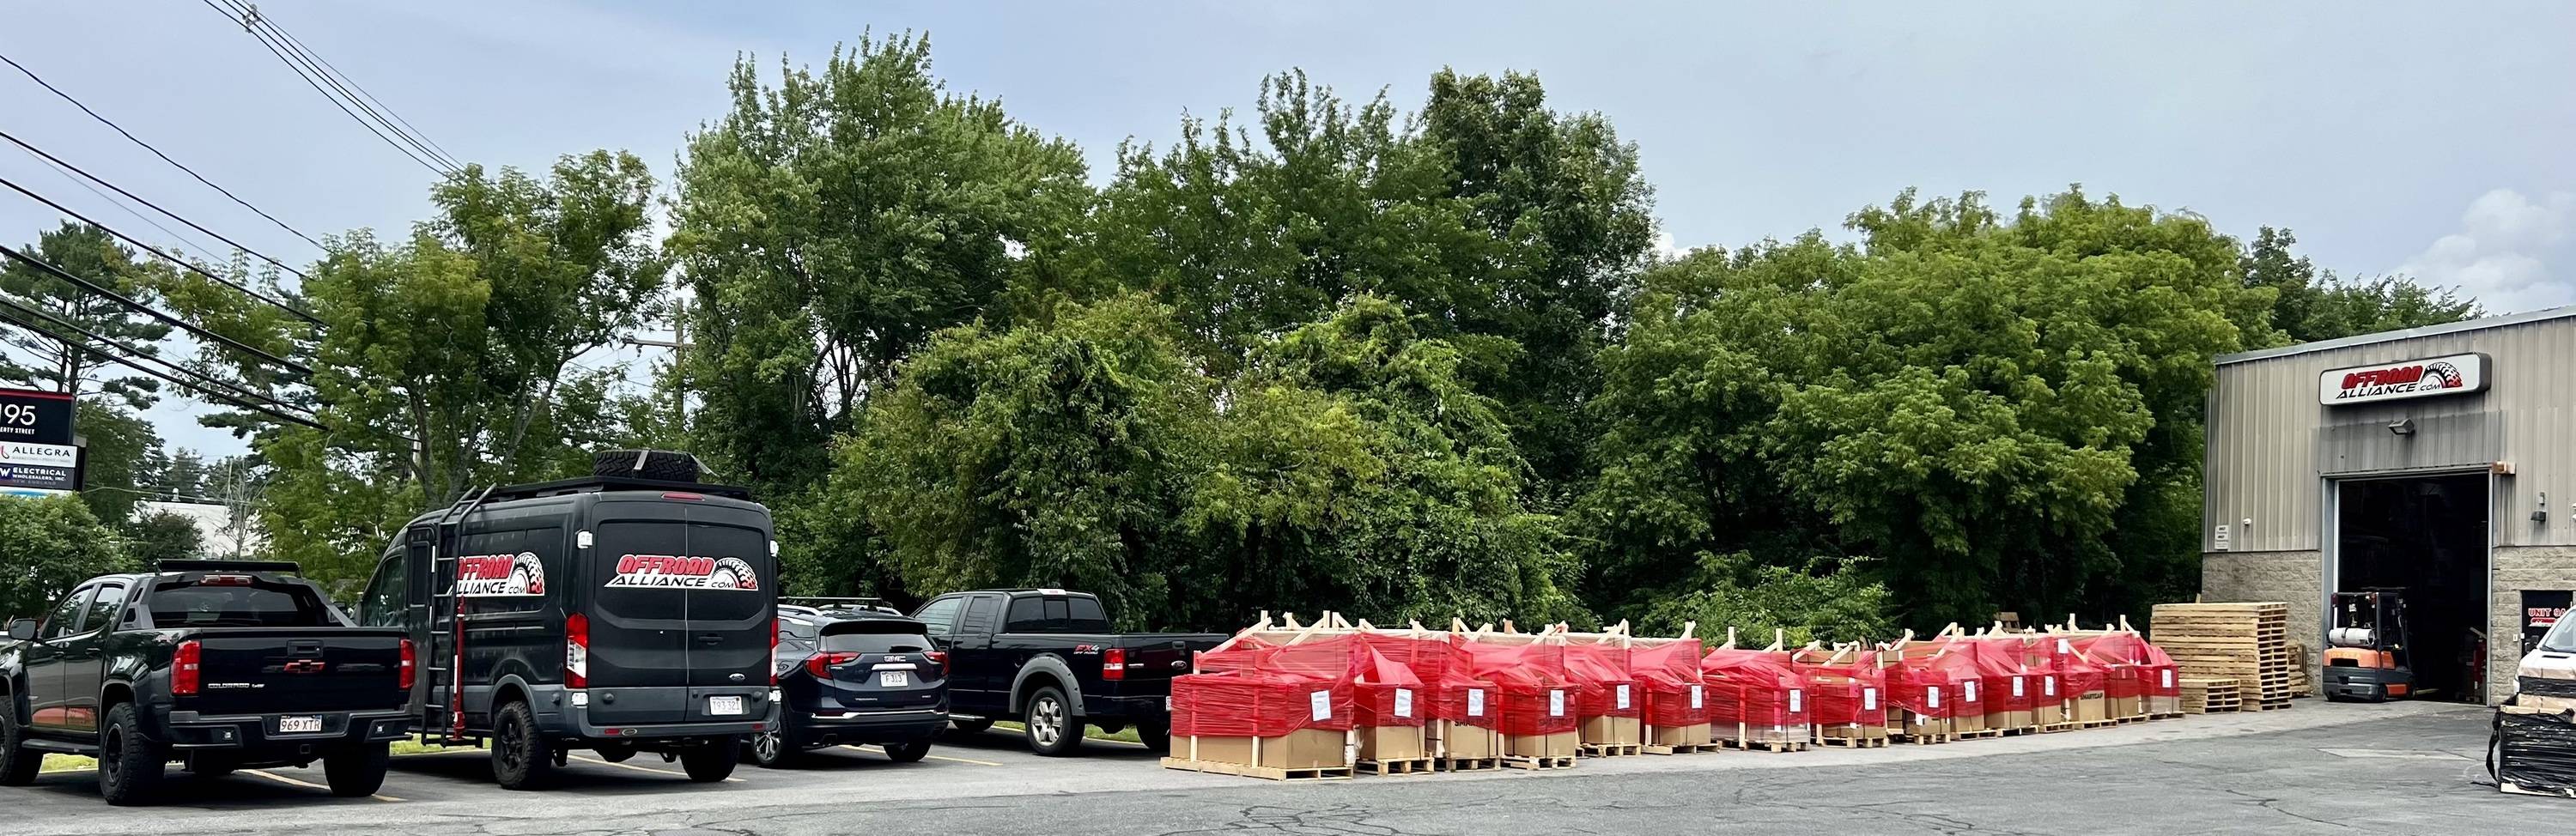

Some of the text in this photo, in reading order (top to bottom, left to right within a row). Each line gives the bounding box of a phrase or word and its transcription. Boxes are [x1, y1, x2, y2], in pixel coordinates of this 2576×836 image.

[2341, 366, 2423, 389] OFFROAD
[2336, 383, 2418, 399] ALLIANCE
[12, 446, 70, 457] ALLEGRA
[13, 467, 67, 476] ELECTRICAL
[617, 555, 714, 576] OFFROAD
[611, 575, 708, 587] ALLIANCE
[454, 581, 507, 594] LLIANCE
[2528, 608, 2552, 617] UNIT
[281, 719, 320, 730] 969 XTR
